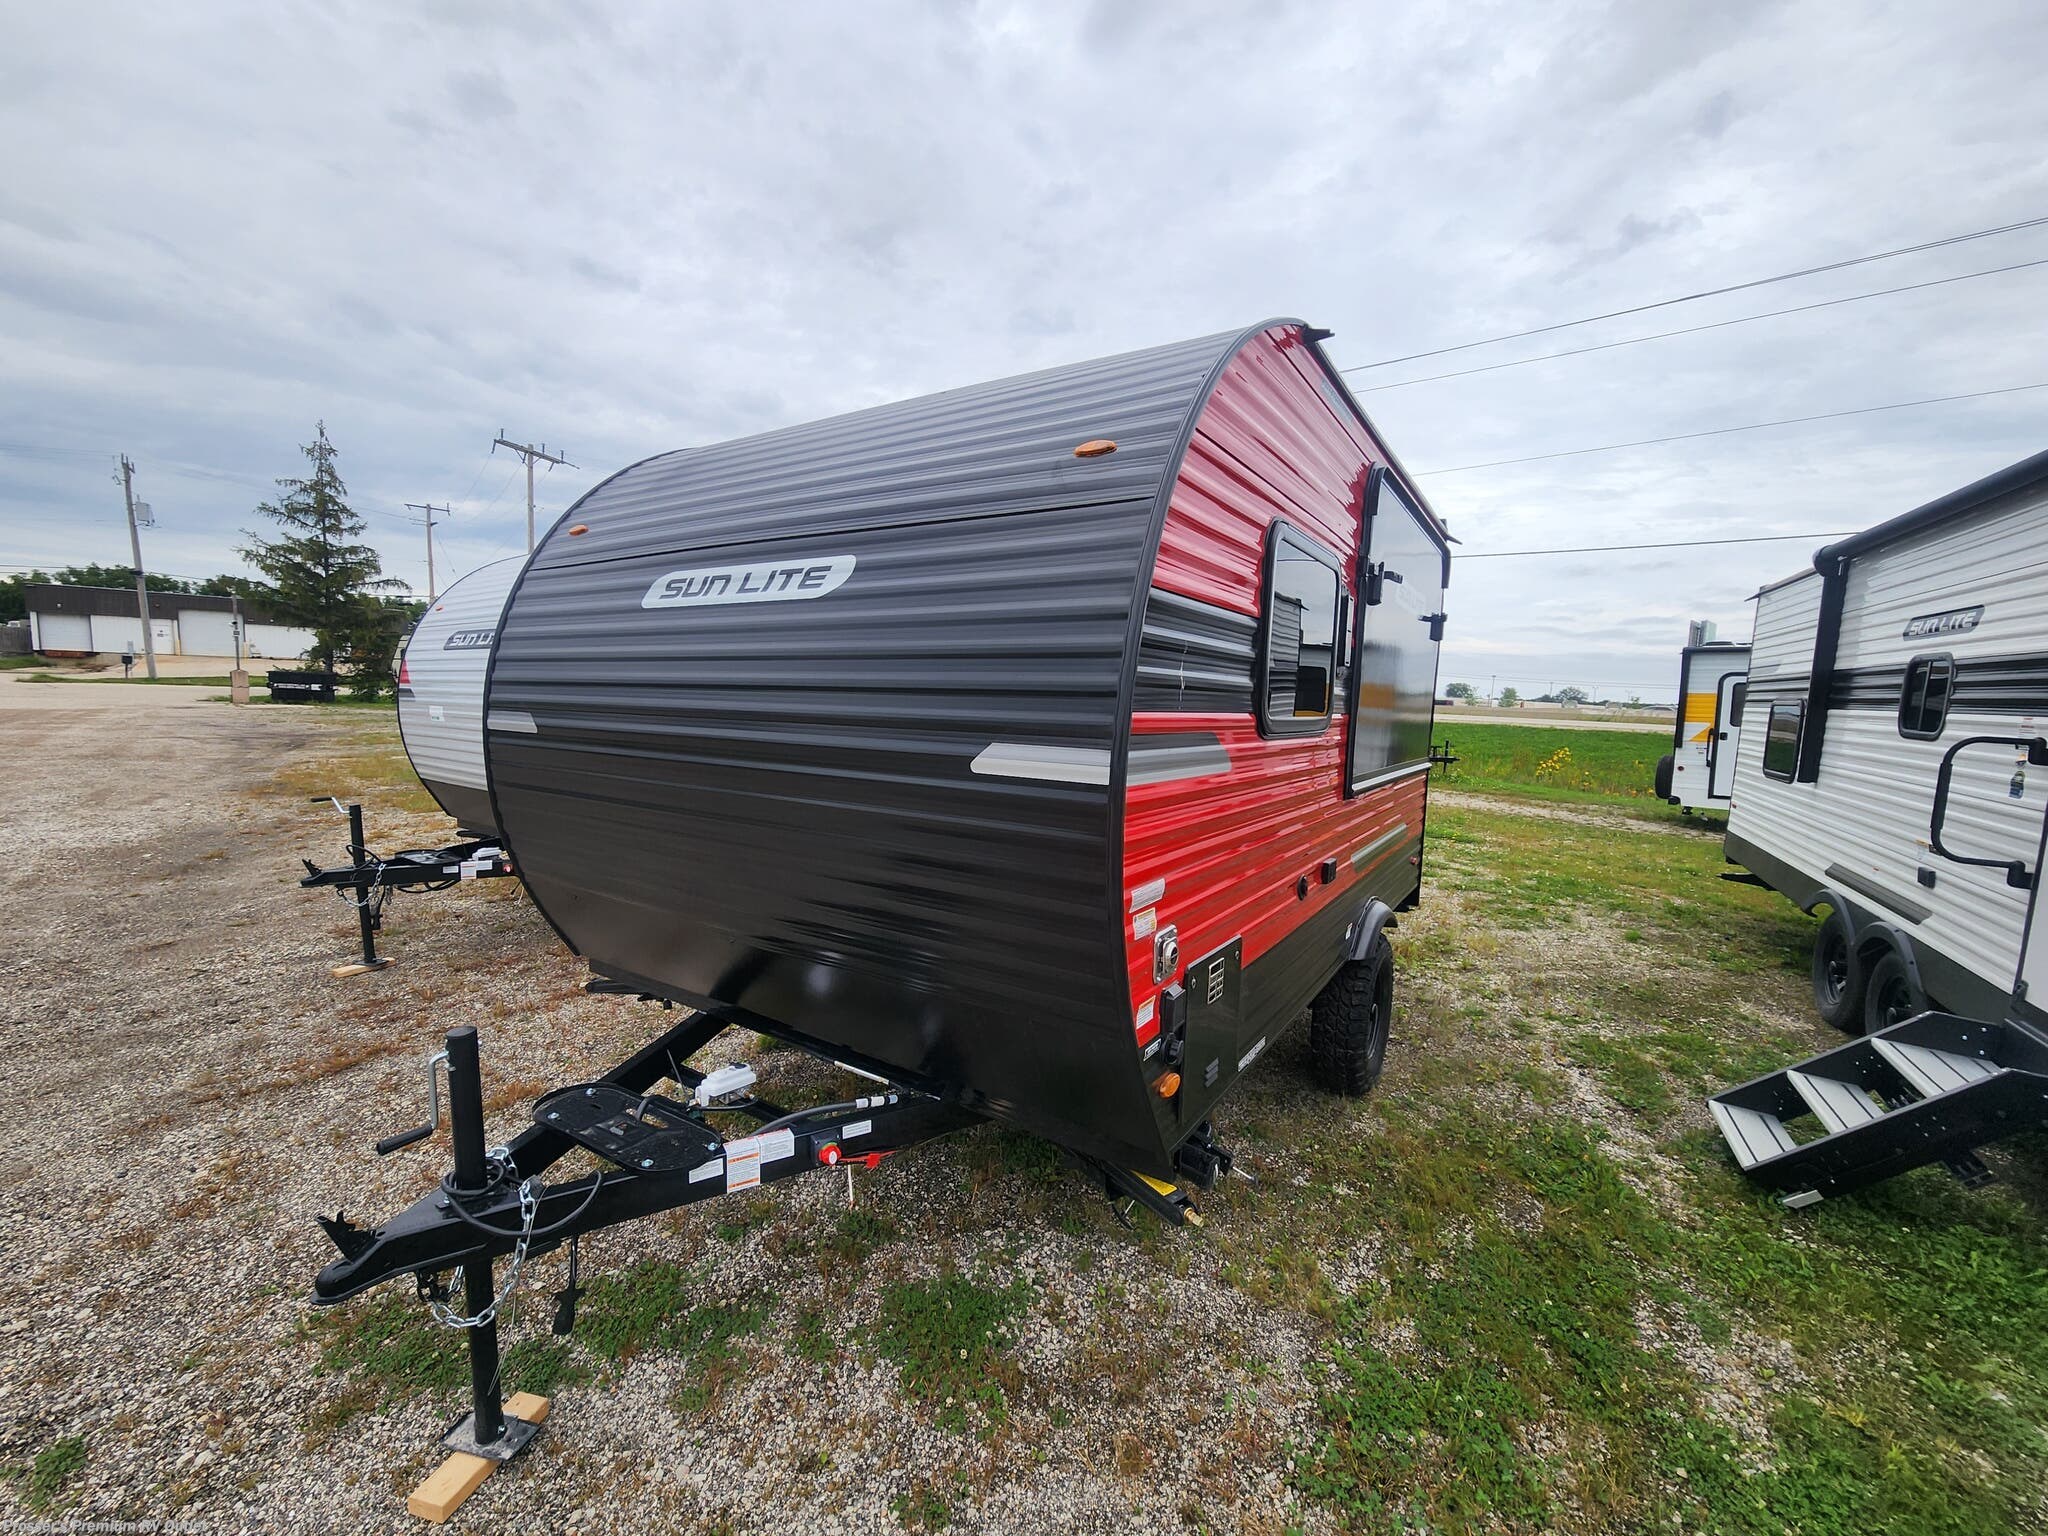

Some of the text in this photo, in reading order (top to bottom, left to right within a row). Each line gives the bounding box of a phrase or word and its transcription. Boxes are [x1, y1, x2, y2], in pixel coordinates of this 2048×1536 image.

[659, 565, 832, 600] SUN LITE
[1909, 611, 1977, 636] SUN LITE
[449, 632, 497, 647] SUN LI
